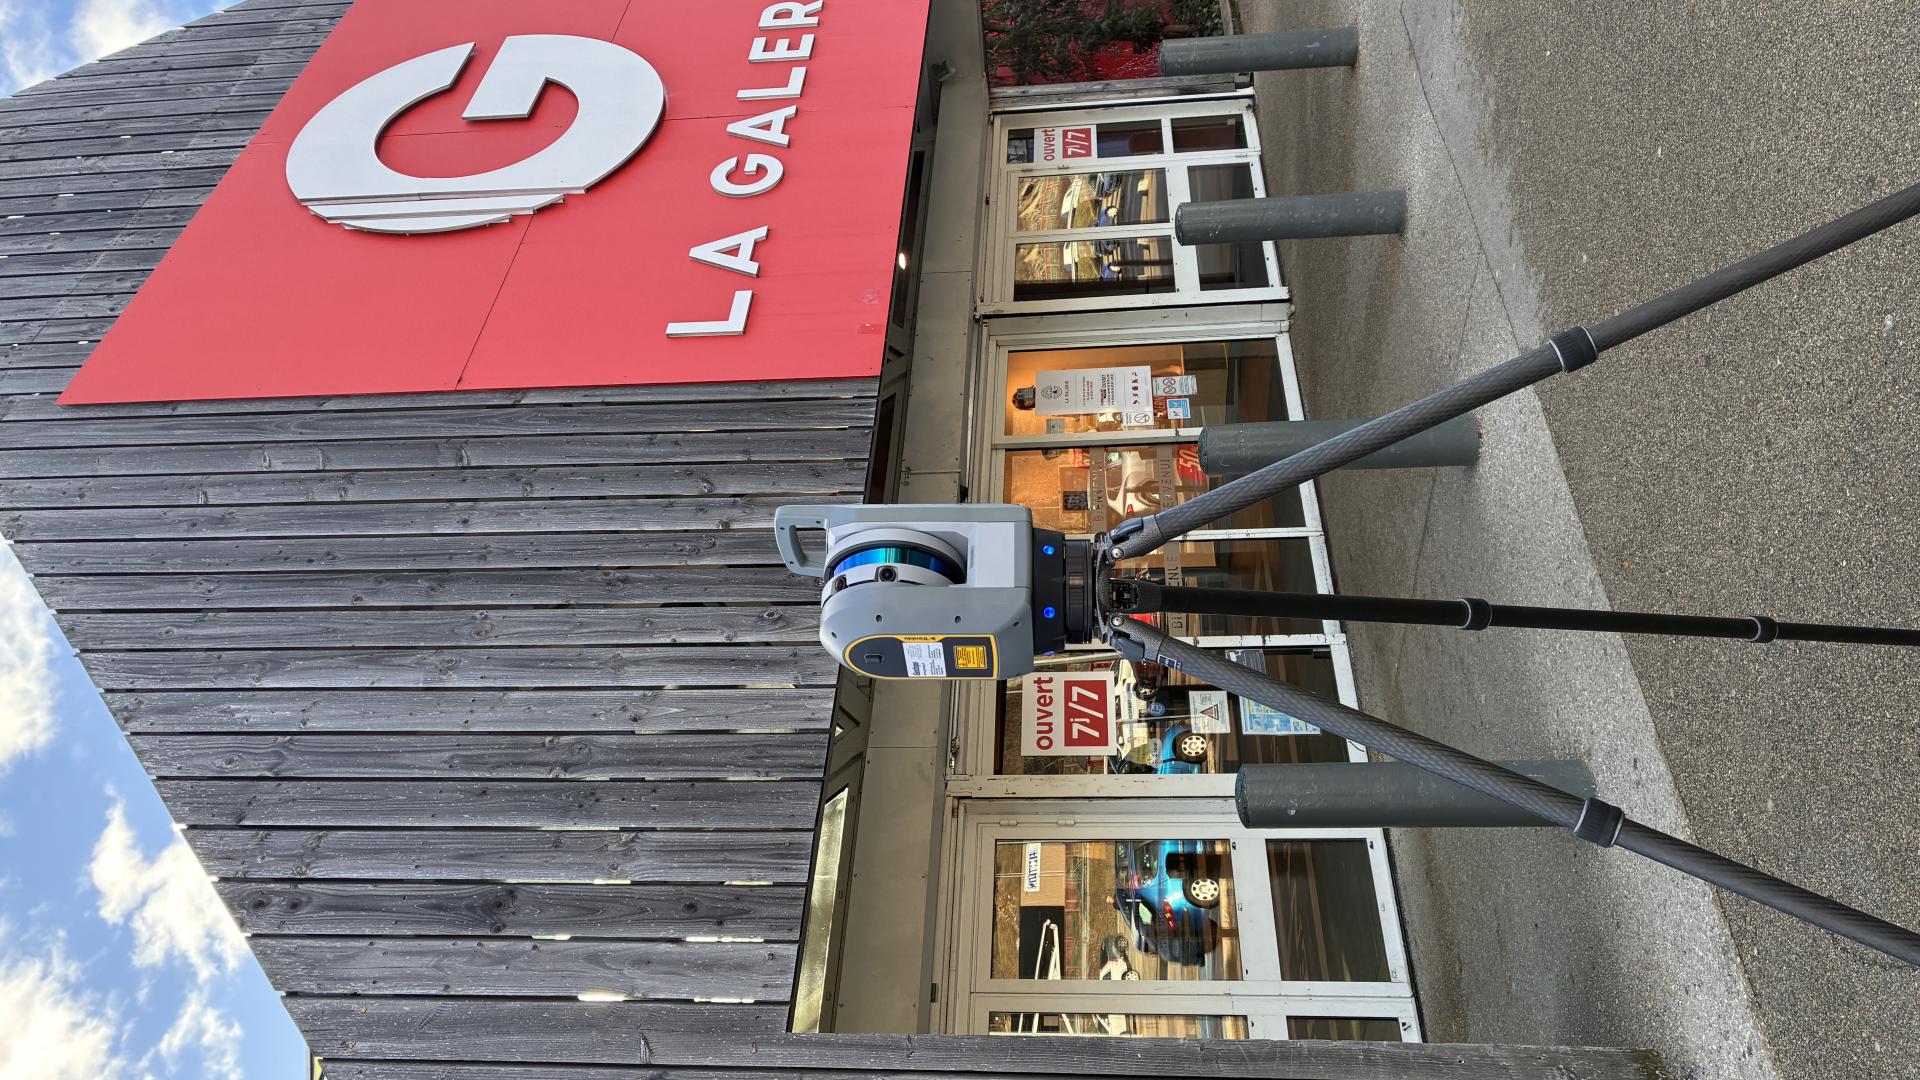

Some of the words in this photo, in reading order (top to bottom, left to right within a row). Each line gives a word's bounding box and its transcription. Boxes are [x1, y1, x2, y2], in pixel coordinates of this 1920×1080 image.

[709, 0, 823, 197] GALER
[1041, 128, 1055, 161] ouvert
[665, 225, 768, 337] LA
[1033, 677, 1053, 750] ouvert
[1068, 686, 1104, 739] 7j/7
